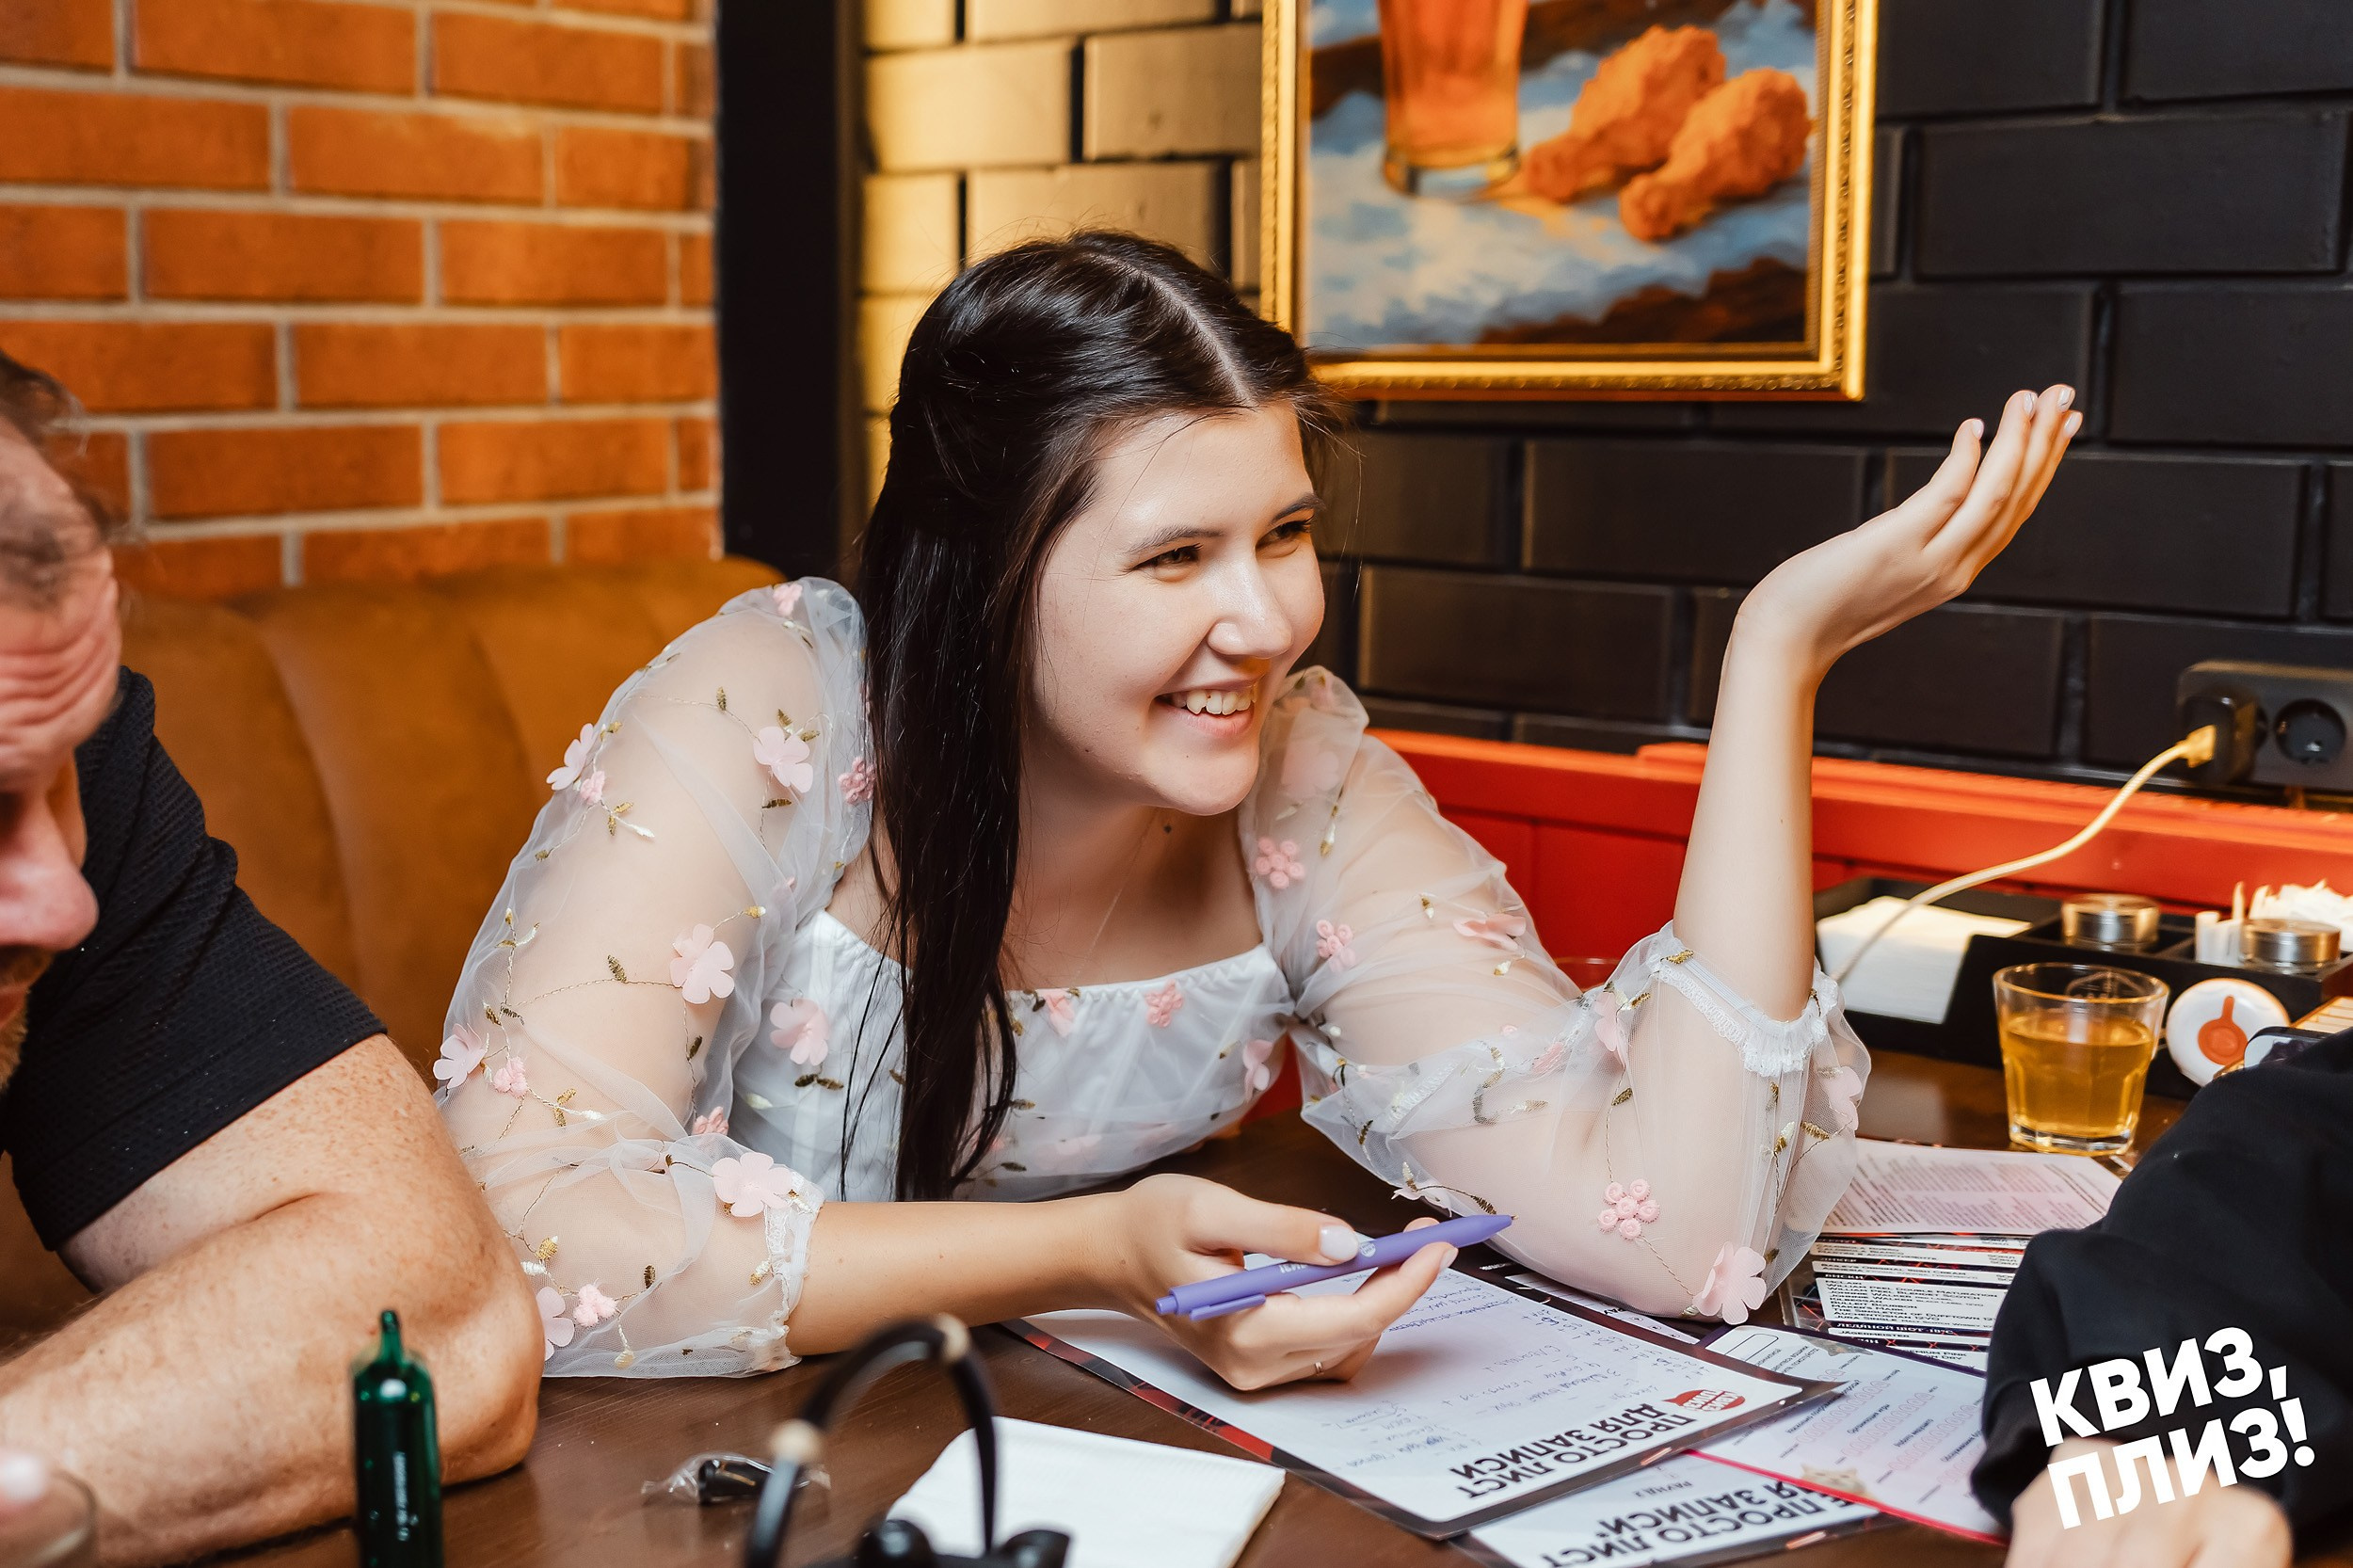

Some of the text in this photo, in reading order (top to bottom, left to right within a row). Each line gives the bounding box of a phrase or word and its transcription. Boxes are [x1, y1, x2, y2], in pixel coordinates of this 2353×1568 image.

[1589, 1403, 1667, 1432] ДЛЯ
[1451, 1430, 1597, 1480] ЗАПИСИ
[1458, 1415, 1697, 1498] ПРОСТО ЛИСТ
[1643, 1480, 1692, 1495] РАУНД
[1657, 1498, 1827, 1543] ПРОСТО
[1541, 1535, 1654, 1568] ЛИСТ
